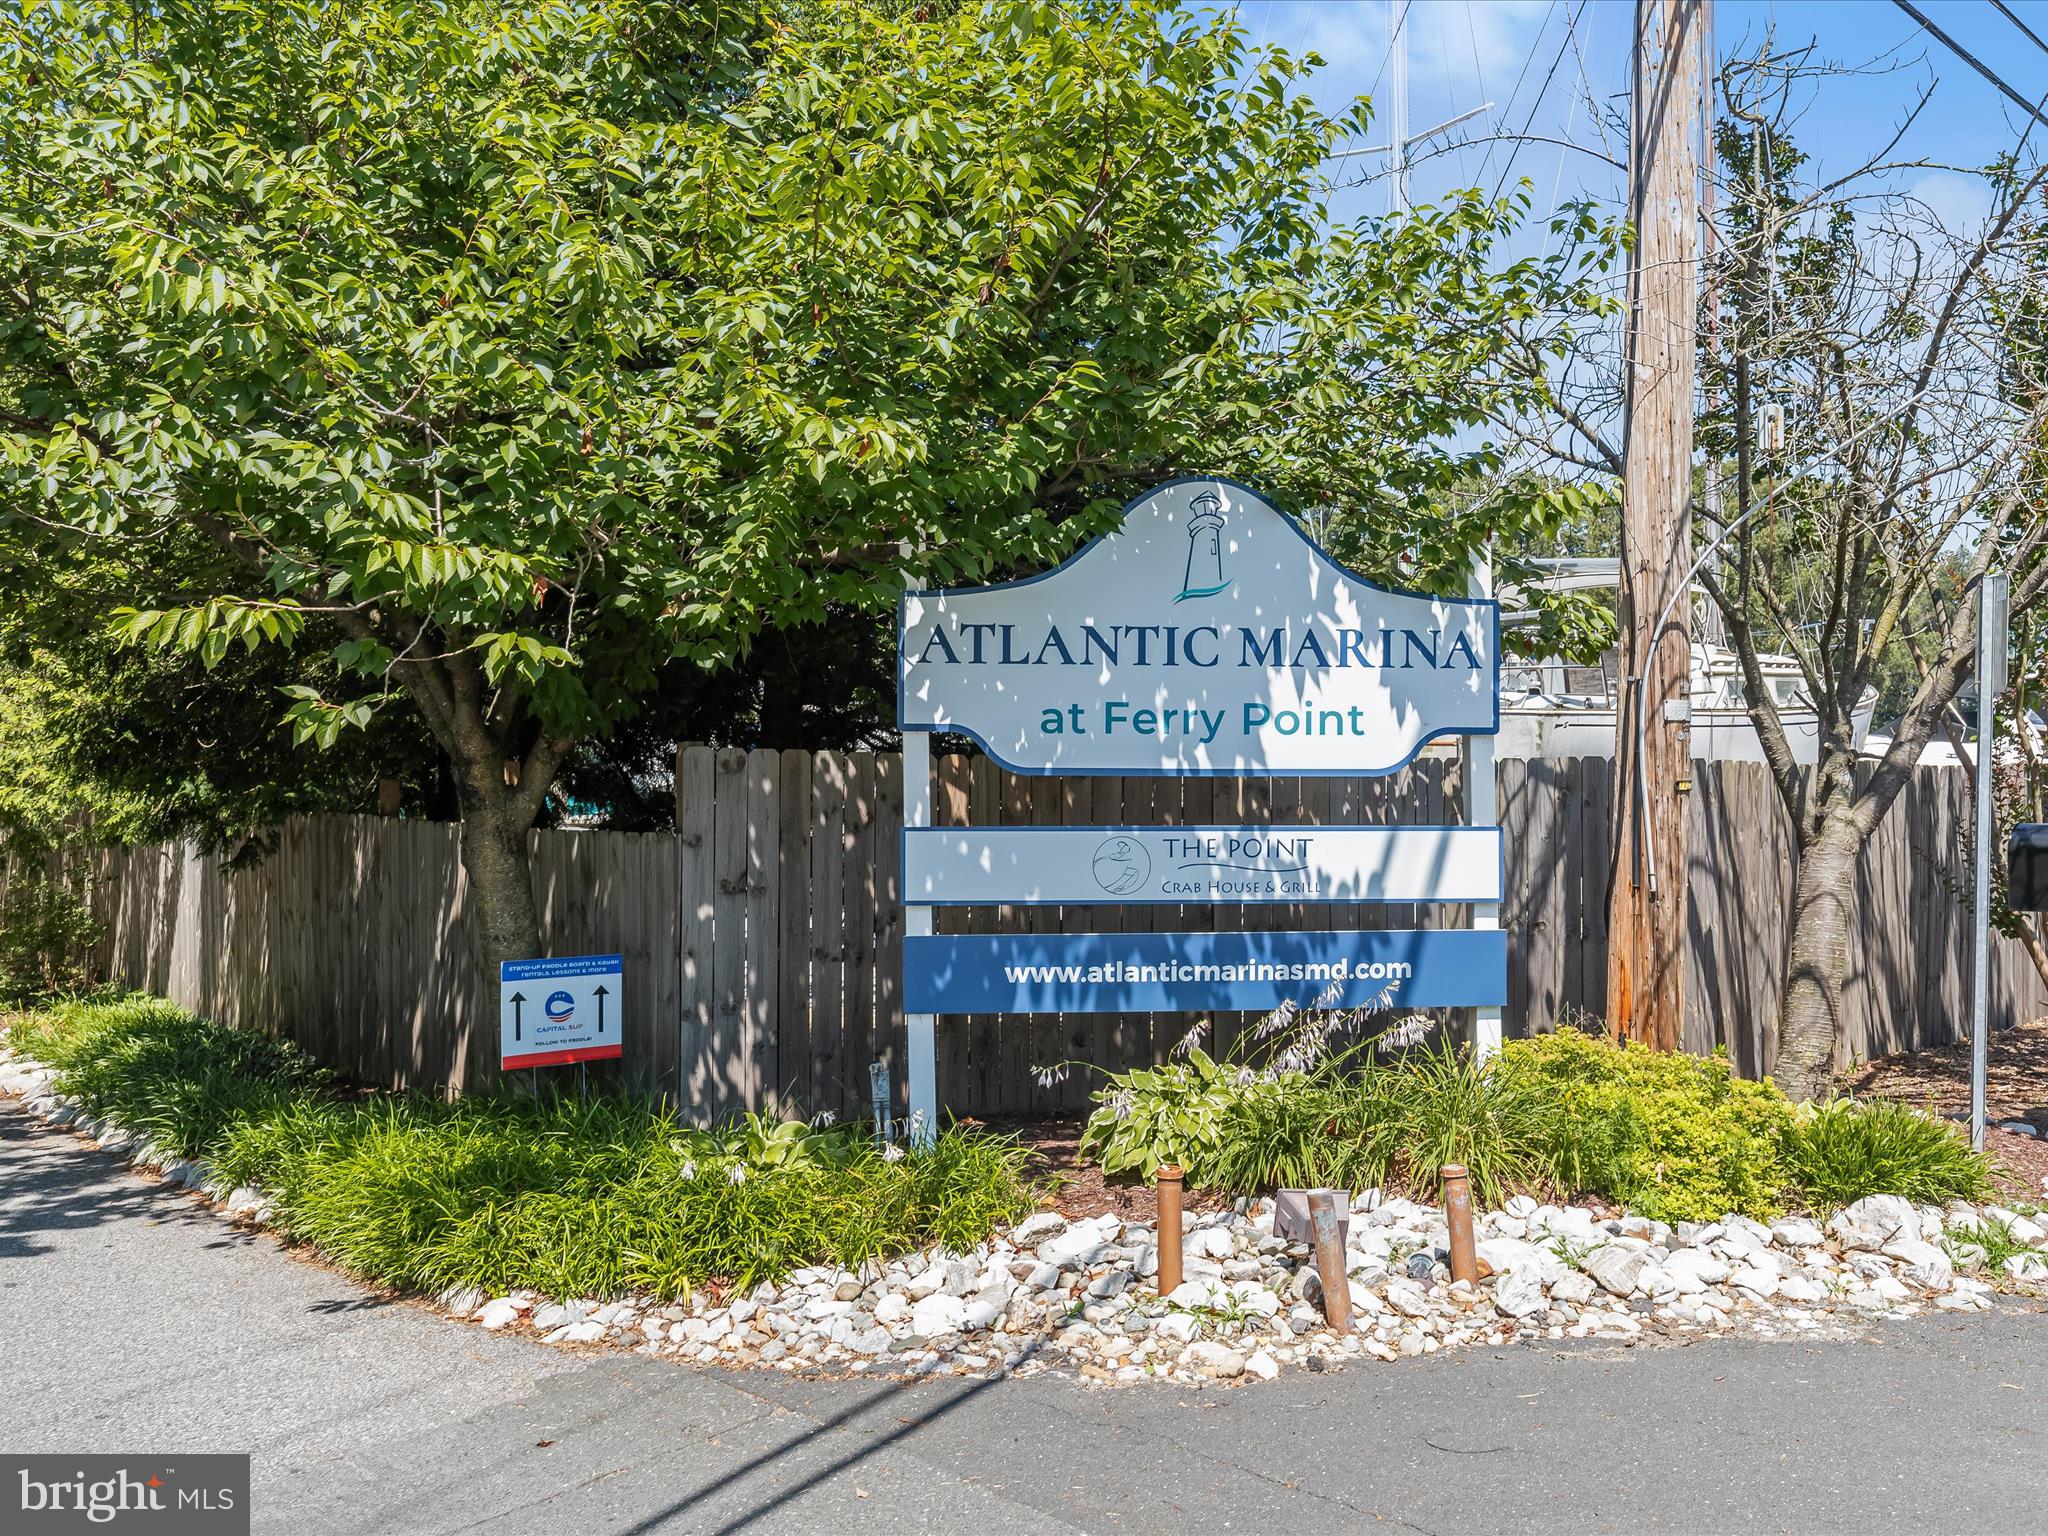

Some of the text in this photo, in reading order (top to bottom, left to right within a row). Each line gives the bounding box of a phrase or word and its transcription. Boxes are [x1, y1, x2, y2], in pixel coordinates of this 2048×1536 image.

[918, 622, 1485, 671] ATLANTIC MARINA
[1040, 701, 1366, 744] at Ferry Point
[1162, 838, 1314, 858] THE POINT
[1161, 880, 1321, 894] CRAB HOUSE & GRILL
[1004, 958, 1412, 985] www.atlanticmarinasmd.com
[536, 1025, 567, 1033] CAPITAL
